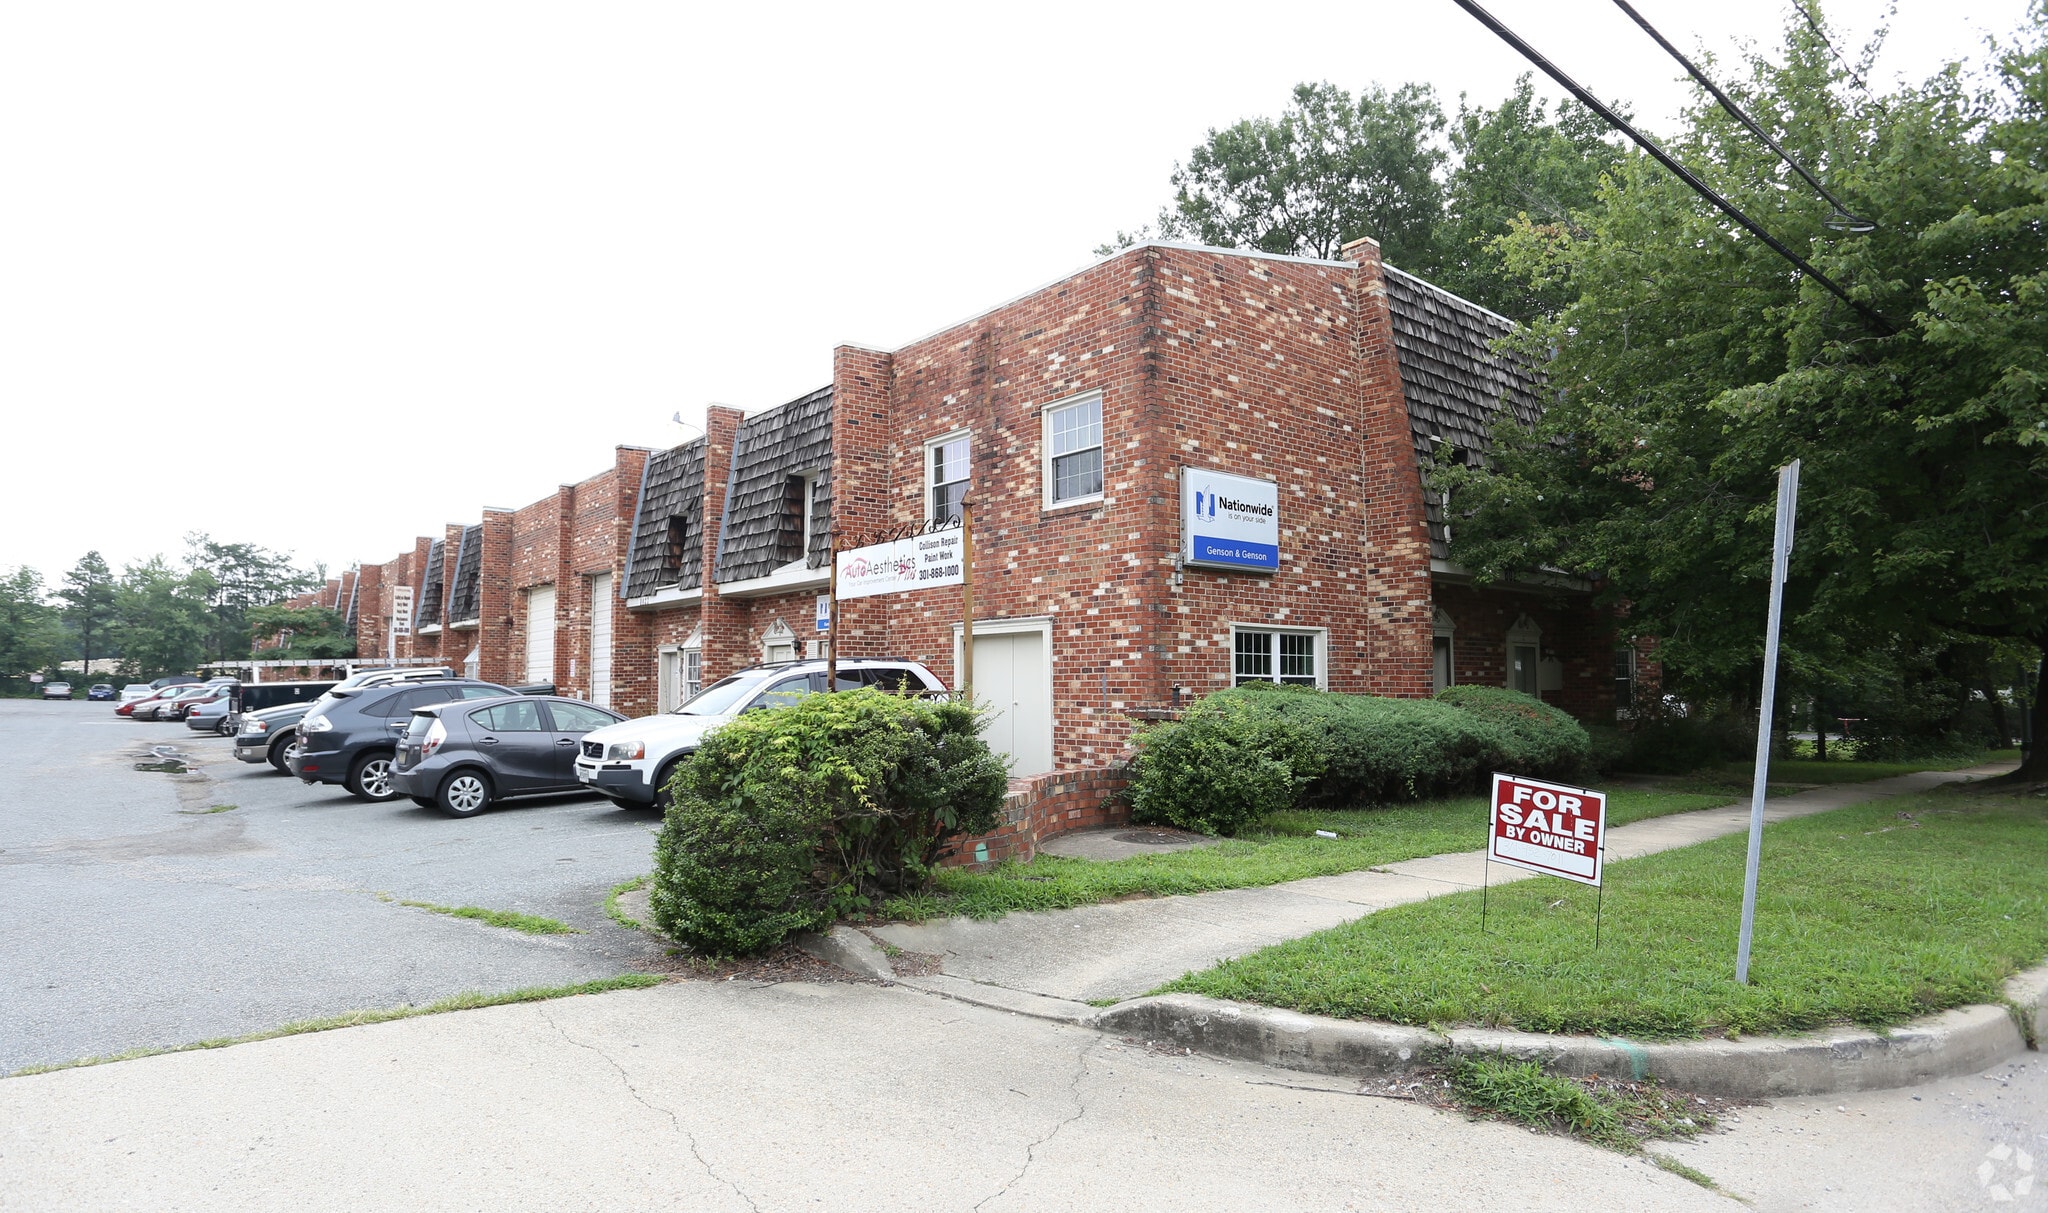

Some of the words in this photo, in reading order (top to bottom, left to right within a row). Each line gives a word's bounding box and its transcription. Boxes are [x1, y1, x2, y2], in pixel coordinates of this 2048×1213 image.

[1219, 496, 1272, 516] Nationwide
[919, 540, 940, 550] Collison
[941, 536, 958, 547] Repair
[924, 552, 938, 563] Paint
[939, 550, 953, 560] Work
[1206, 546, 1234, 558] Genson
[1235, 549, 1241, 558] &
[1242, 550, 1267, 561] Genson
[919, 564, 959, 580] 301-868-1000
[1513, 786, 1582, 816] FOR
[1499, 803, 1596, 842] SALE
[1505, 824, 1526, 840] BY
[1530, 830, 1586, 854] OWNER
